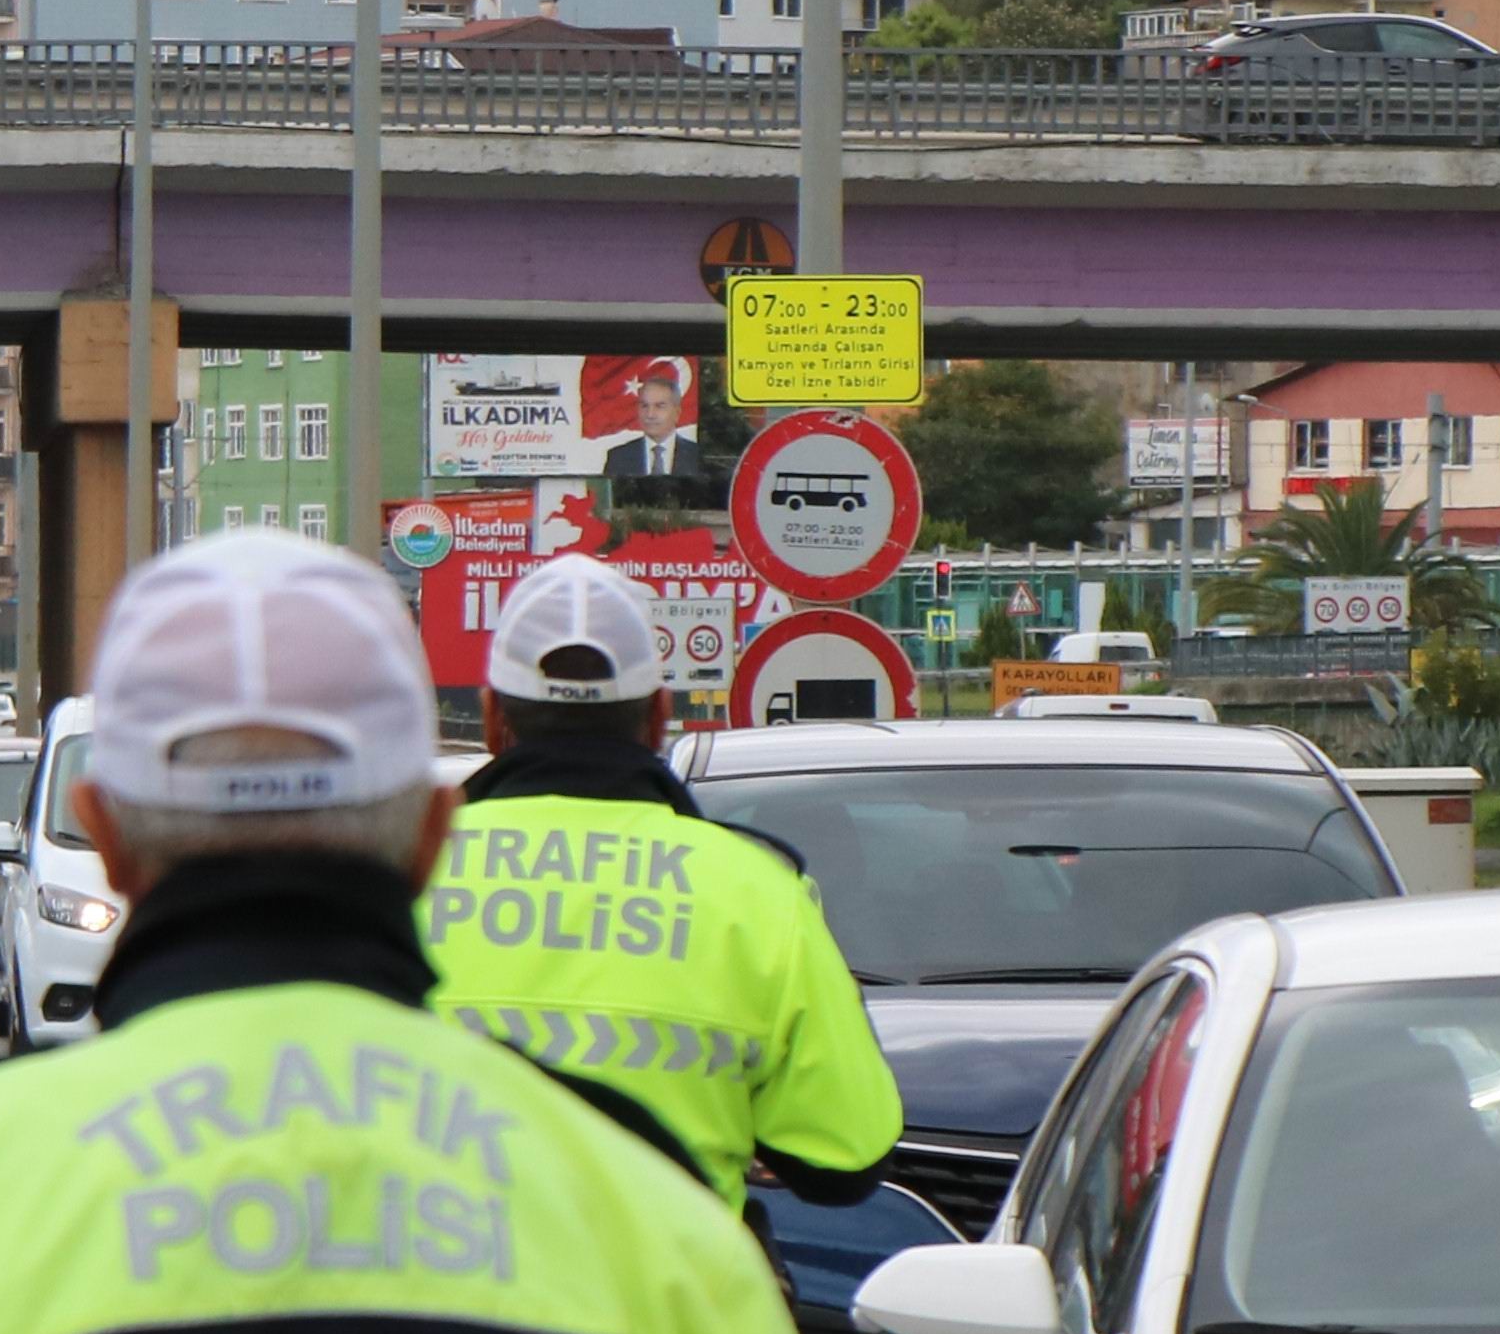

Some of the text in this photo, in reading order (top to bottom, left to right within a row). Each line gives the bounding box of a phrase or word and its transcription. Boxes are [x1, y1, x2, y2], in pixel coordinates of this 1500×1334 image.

[743, 294, 806, 318] 07:00
[846, 293, 908, 318] 23:00
[765, 323, 886, 335] Saatleri Arasında
[767, 340, 884, 354] Limanda Çalışan
[738, 358, 915, 372] Kamyon ve Tırların Girişi
[766, 373, 887, 388] Özel İzne Tabidir
[455, 513, 526, 536] İlkadım
[455, 536, 526, 554] Belediyesi
[782, 534, 830, 545] Saatleri
[467, 560, 512, 577] MİLLİ
[651, 561, 746, 579] BAŞLADIĞI
[669, 605, 727, 619] Bölgesi
[1320, 602, 1396, 616] 70 50 50
[692, 635, 716, 651] 50
[1002, 669, 1112, 684] KARAYOLLARI
